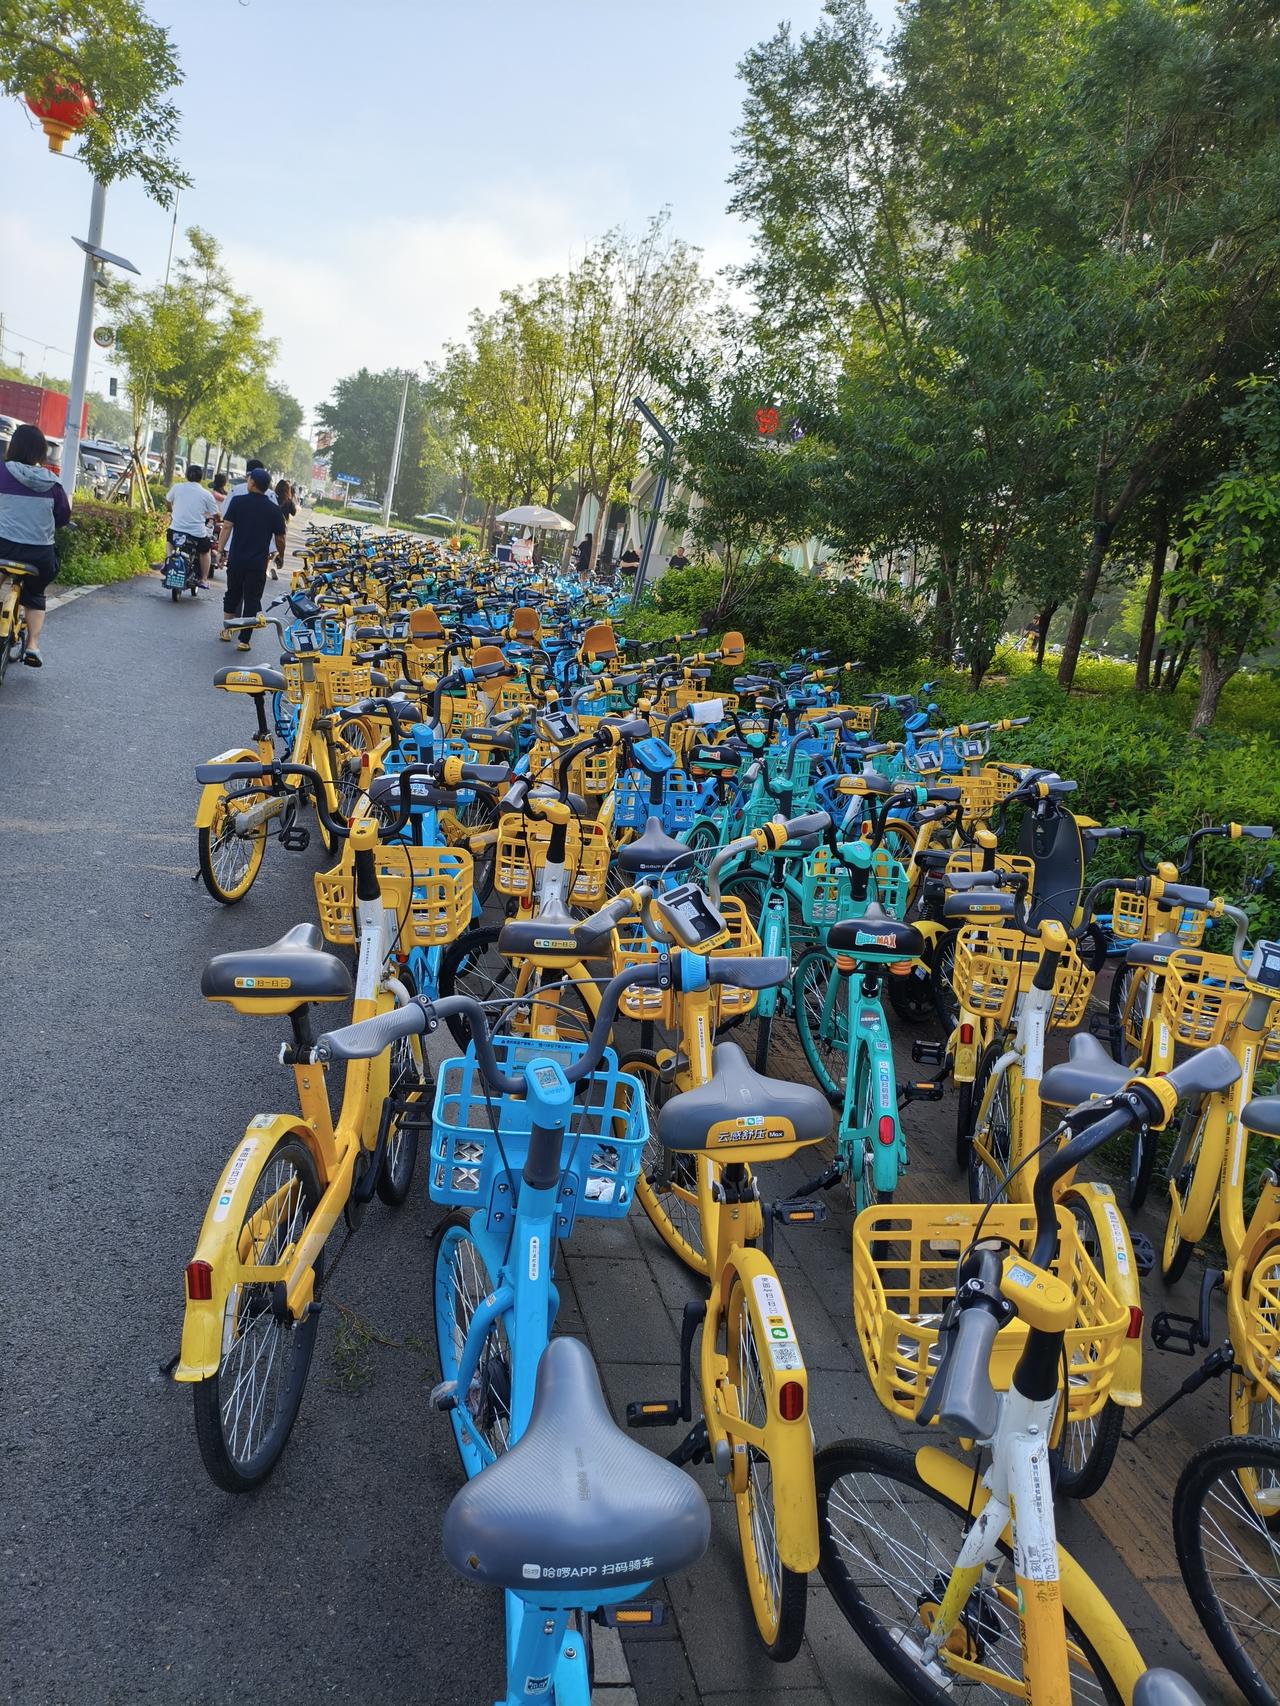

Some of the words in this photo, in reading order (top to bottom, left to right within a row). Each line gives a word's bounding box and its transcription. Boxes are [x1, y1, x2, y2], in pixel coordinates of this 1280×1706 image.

[718, 1128, 767, 1142] 云感舒压
[542, 1566, 597, 1578] 哈啰APP
[601, 1556, 654, 1576] 扫码骑车
